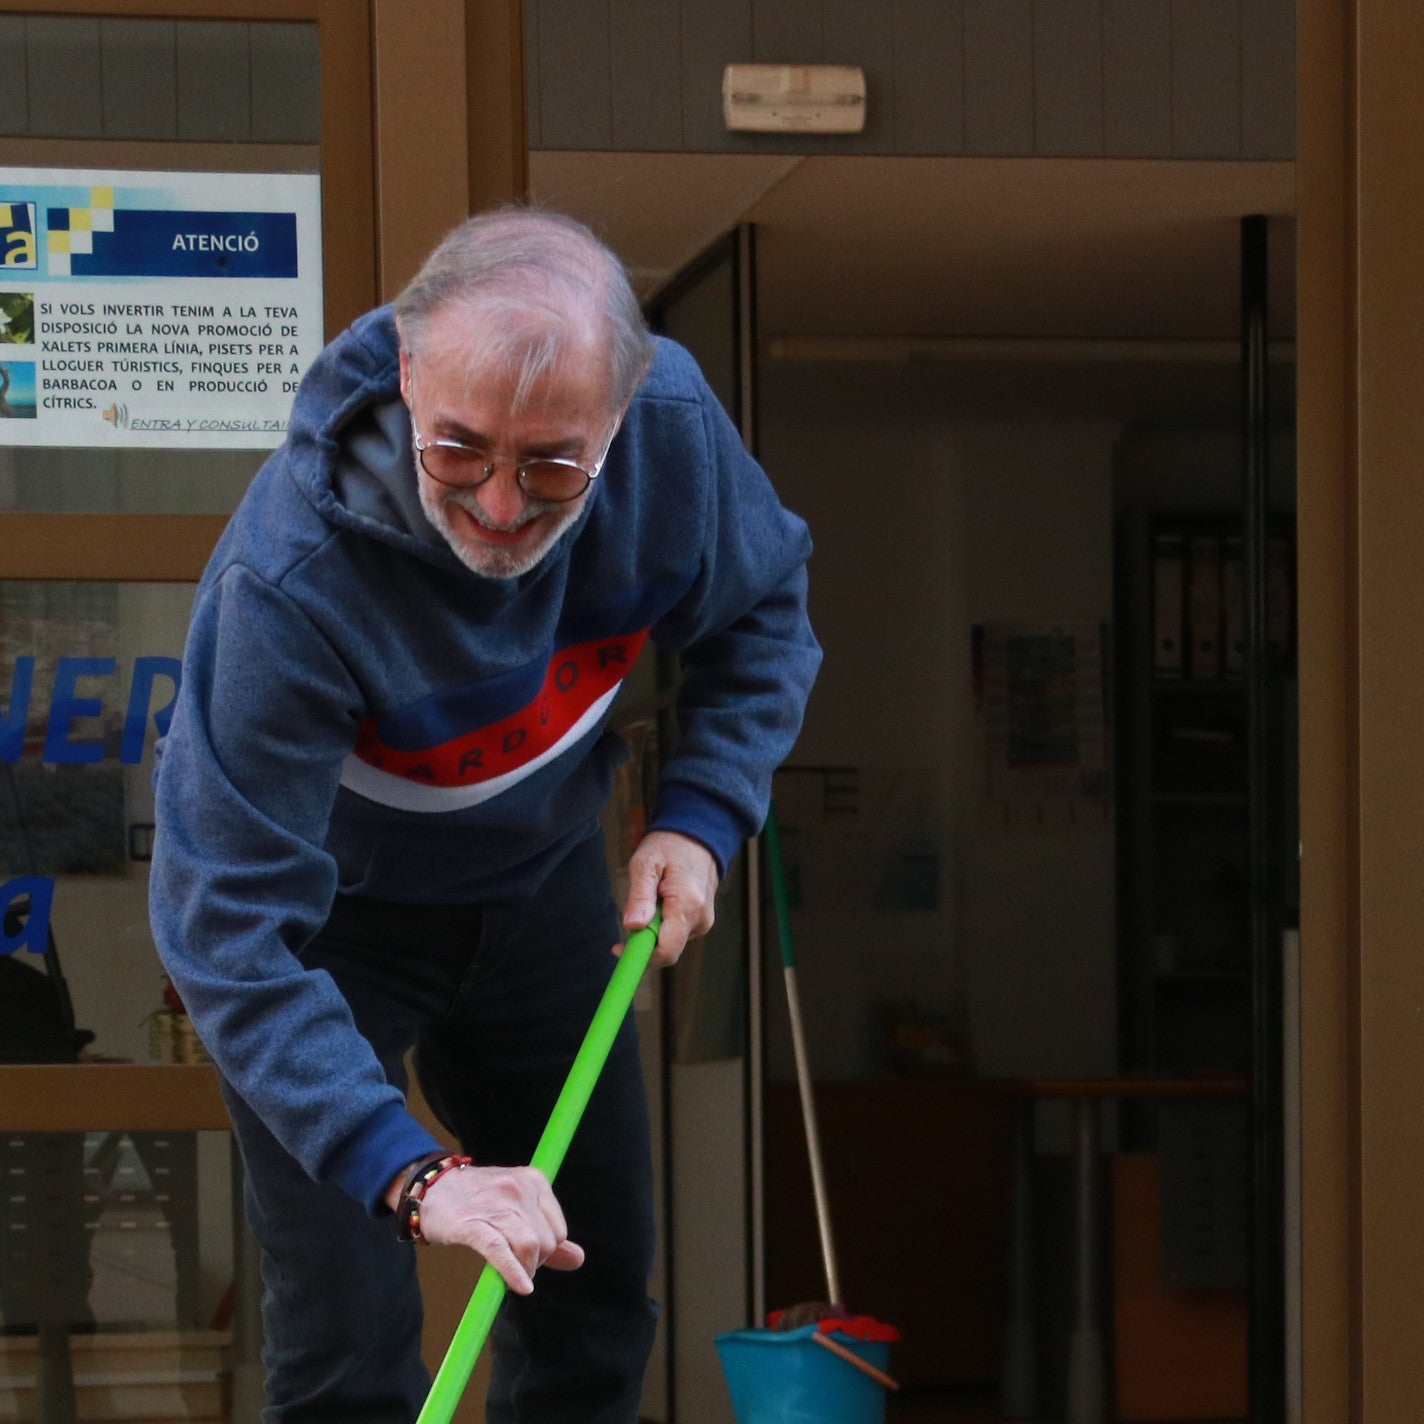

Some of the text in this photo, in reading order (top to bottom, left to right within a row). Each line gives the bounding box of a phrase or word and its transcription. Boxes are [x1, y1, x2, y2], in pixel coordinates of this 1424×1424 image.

[172, 231, 259, 252] ATENCIÓ
[41, 304, 298, 318] SI VOLS INVERTIR TENIM A LA TEVA
[41, 321, 298, 337] DISPOSICIÓ LA NOVA PROMOCIÓ DE
[42, 341, 299, 356] XALETS PRIMERA LÍNIA, PISETS PER A
[42, 359, 299, 376] LLOGUER TÚRISTICS, FINQUES PER A
[43, 379, 298, 393] BARBACOA O EN PRODUCCIÓ DE
[43, 396, 97, 409] CÍTRICS.
[131, 419, 181, 430] ENTRA
